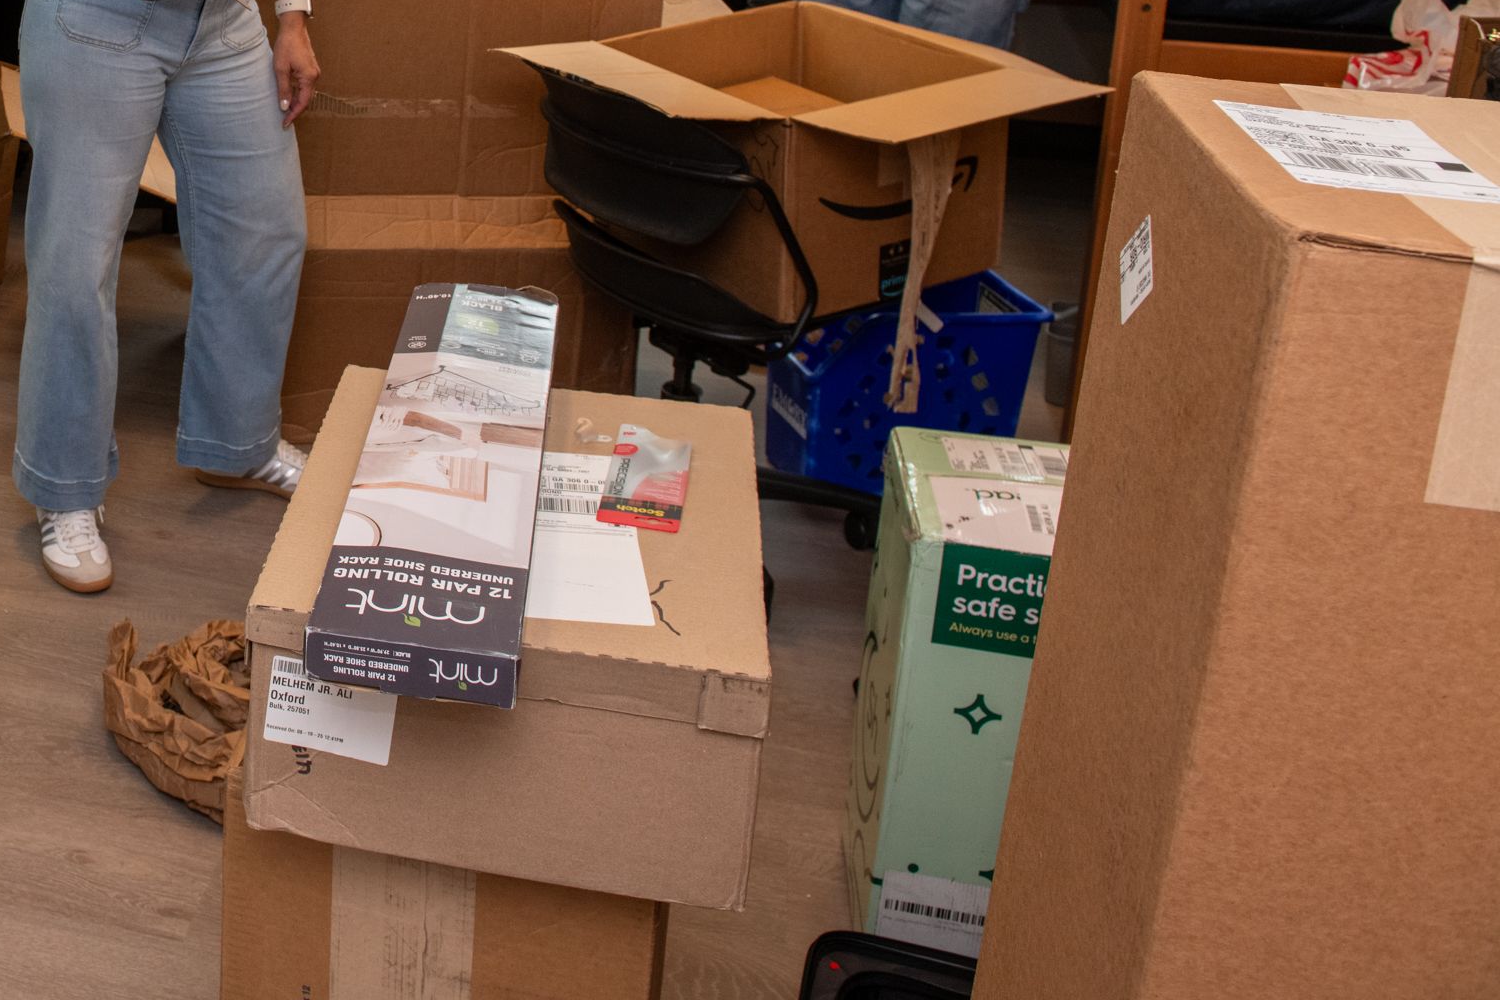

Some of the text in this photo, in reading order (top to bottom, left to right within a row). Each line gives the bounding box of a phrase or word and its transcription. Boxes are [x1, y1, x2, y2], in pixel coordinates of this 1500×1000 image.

[462, 300, 504, 312] BLACK
[613, 458, 631, 496] PRECISION
[616, 504, 665, 517] Scotch
[338, 555, 514, 585] UNDERBED SHOE RACK
[957, 563, 1046, 598] Practi
[333, 567, 512, 599] 12 PAIR ROLLING
[345, 587, 486, 625] mint
[952, 597, 1040, 625] safe s
[949, 622, 1029, 644] Always use a
[323, 654, 409, 672] UNDERBED SHOE RACK
[333, 665, 396, 682] 12 PAIR ROLLING
[428, 658, 498, 686] mint
[270, 689, 305, 705] Oxford
[272, 675, 353, 700] MELHEM JR. ALI
[287, 705, 310, 715] 257051
[266, 723, 287, 732] Received
